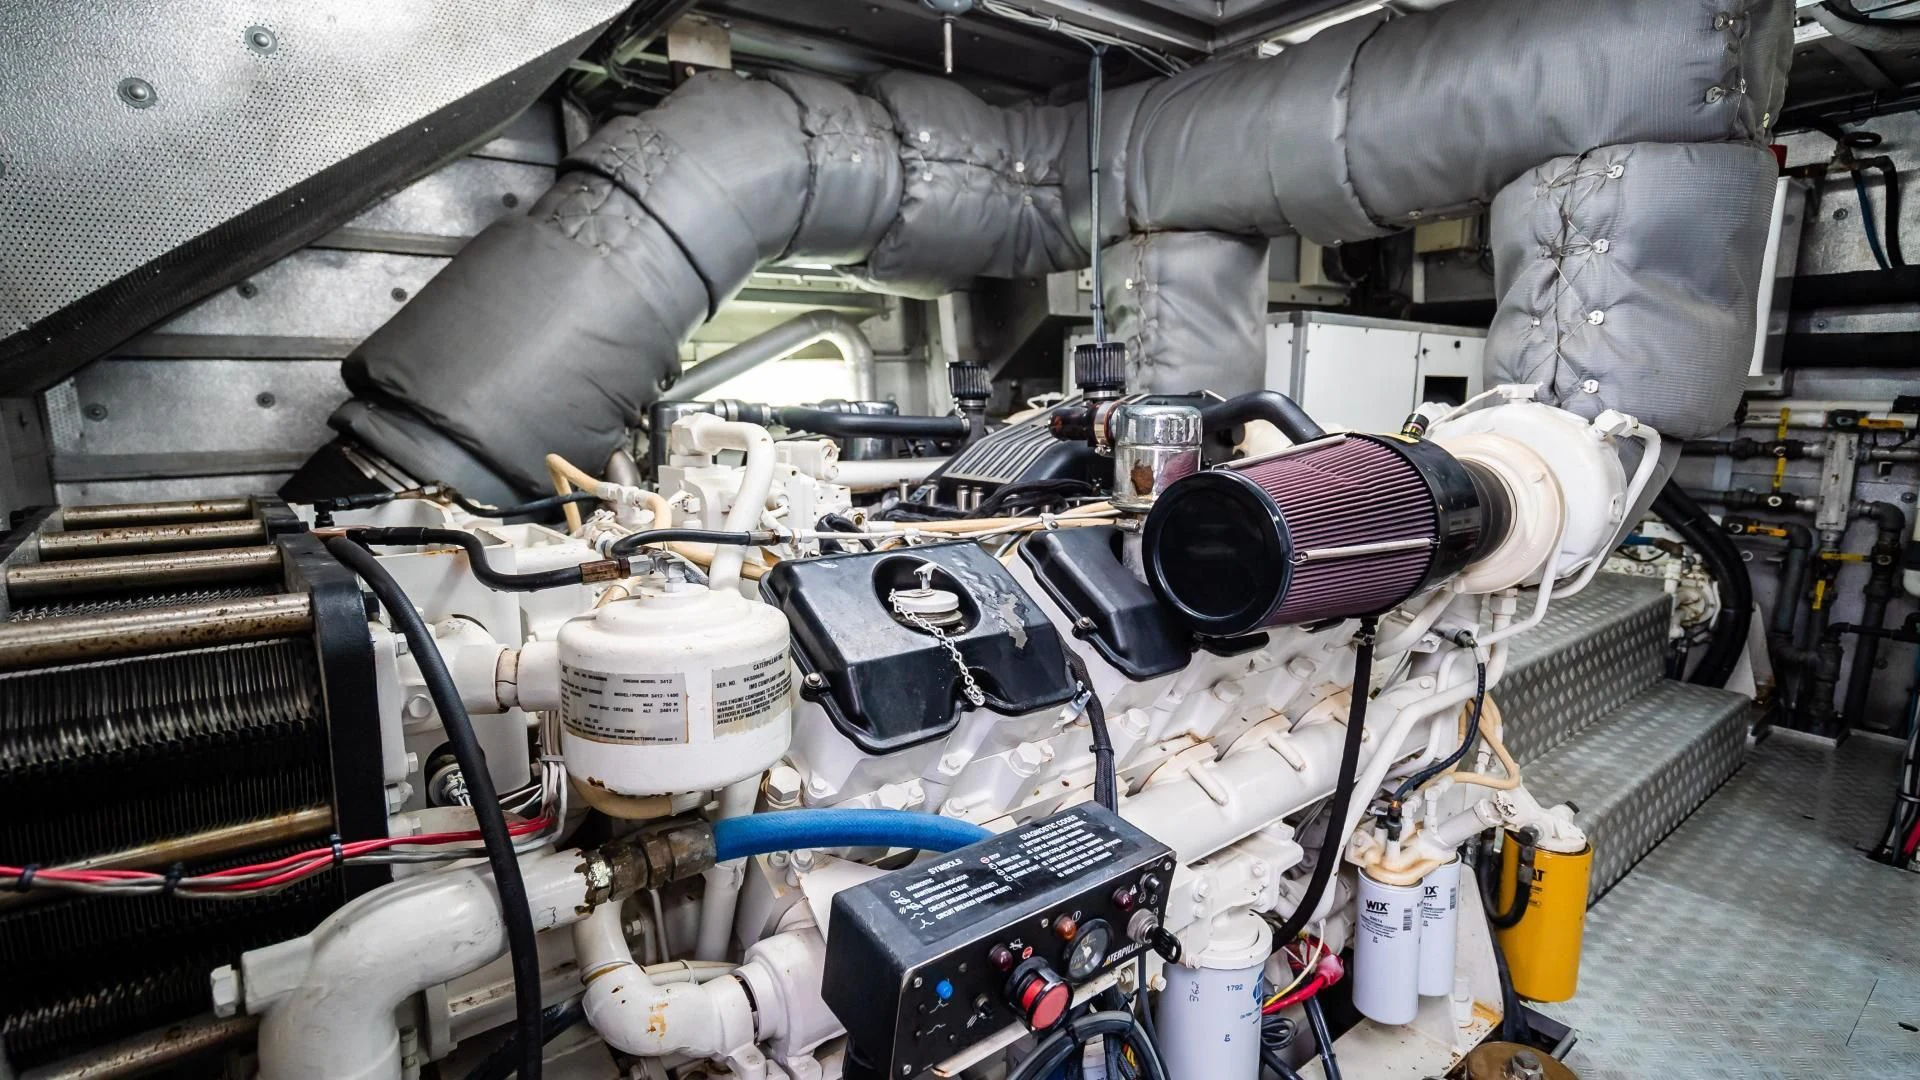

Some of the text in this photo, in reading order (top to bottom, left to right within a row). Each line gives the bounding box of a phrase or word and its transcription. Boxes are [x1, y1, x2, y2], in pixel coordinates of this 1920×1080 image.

[1019, 814, 1079, 841] DIAGNOSTIC CODES
[927, 858, 964, 875] SYMBOLS
[952, 883, 969, 894] CLEAR
[1366, 899, 1388, 912] WIX
[1226, 983, 1244, 992] 1792
